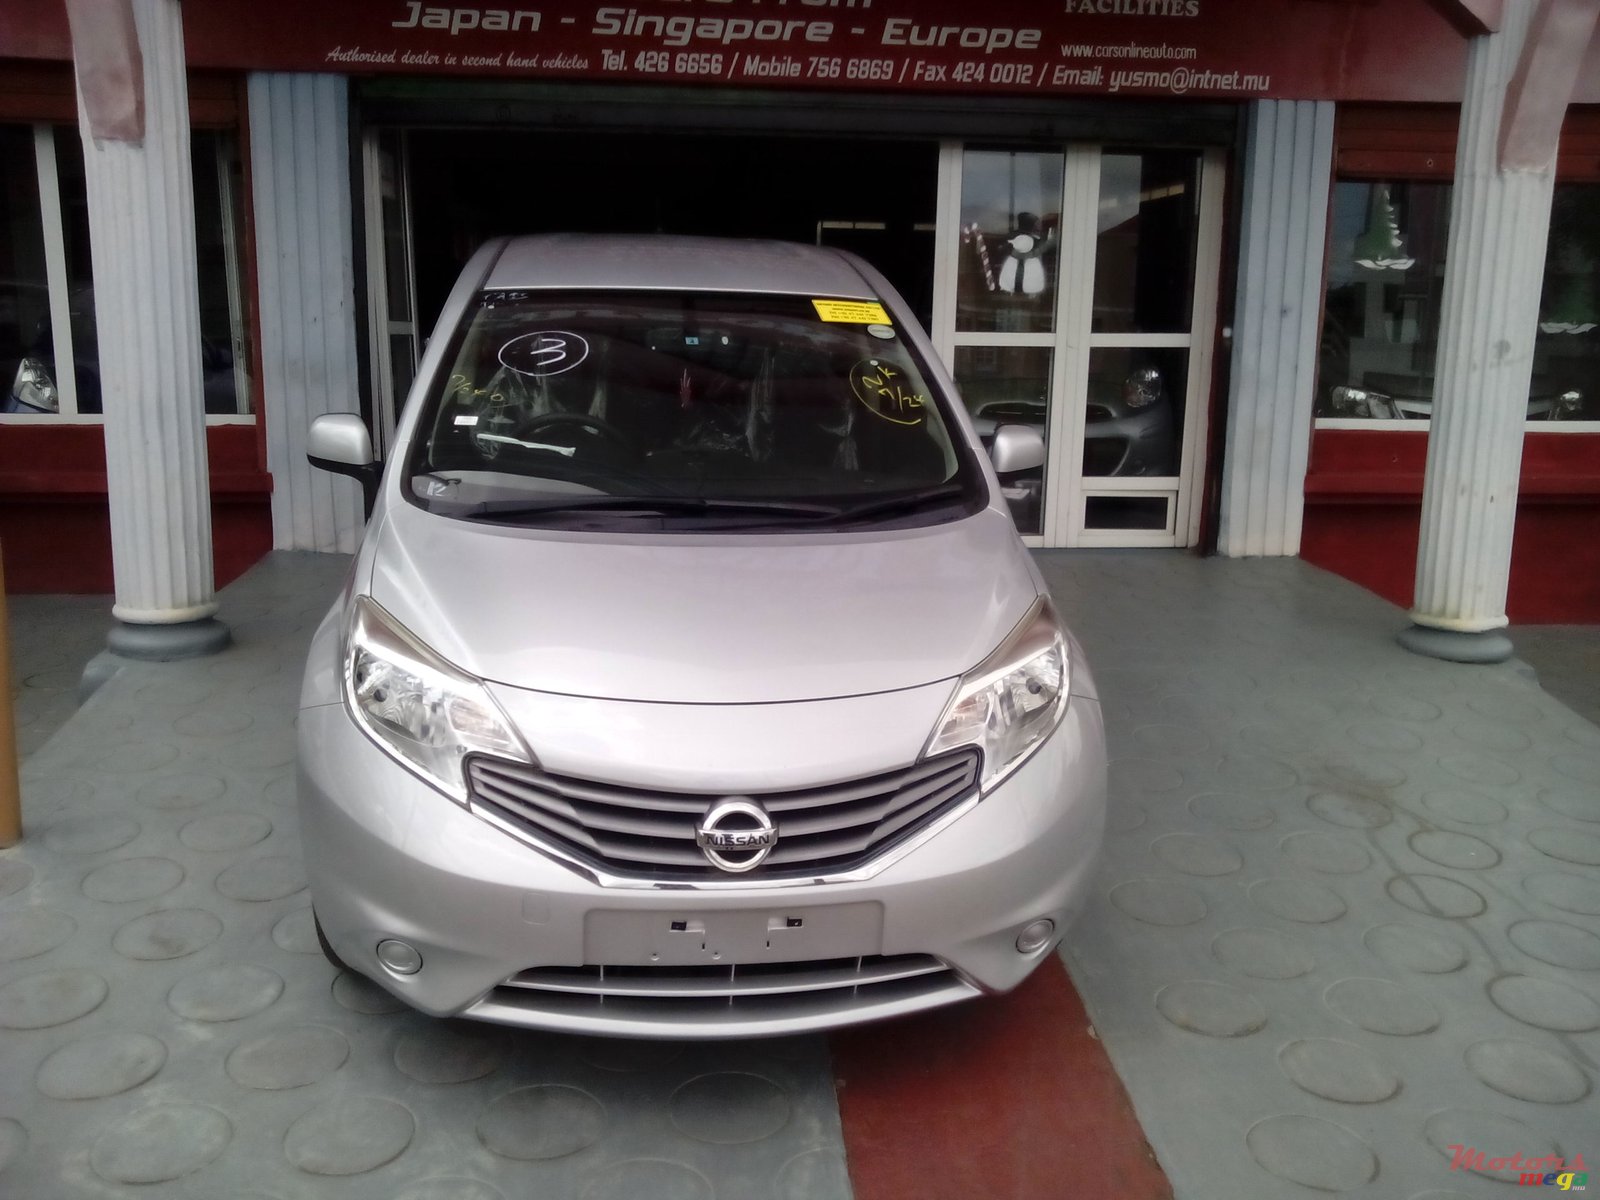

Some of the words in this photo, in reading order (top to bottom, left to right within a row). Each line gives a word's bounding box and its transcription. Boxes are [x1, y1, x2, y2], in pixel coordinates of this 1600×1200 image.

[1064, 0, 1200, 17] FACILITIES
[391, 1, 542, 35] Japan
[592, 7, 834, 47] Singapore
[880, 18, 1043, 54] Europe
[324, 45, 396, 63] Authorised
[401, 50, 440, 65] dealer
[445, 53, 457, 66] in
[462, 51, 502, 67] second
[506, 53, 538, 69] hand
[542, 54, 590, 70] vehicles
[1060, 41, 1197, 60] www.carsonlineauto.com
[601, 49, 628, 71] Tel.
[634, 51, 669, 73] 426
[674, 53, 723, 75] 6656
[743, 54, 801, 77] Mobile
[806, 56, 840, 78] 756
[846, 58, 894, 80] 6869
[913, 60, 947, 82] Fax
[952, 61, 985, 83] 424
[990, 63, 1034, 84] 0012
[1109, 66, 1271, 94] yusmo@intnet.mu
[530, 338, 567, 366] 3
[706, 833, 770, 847] NISSAN
